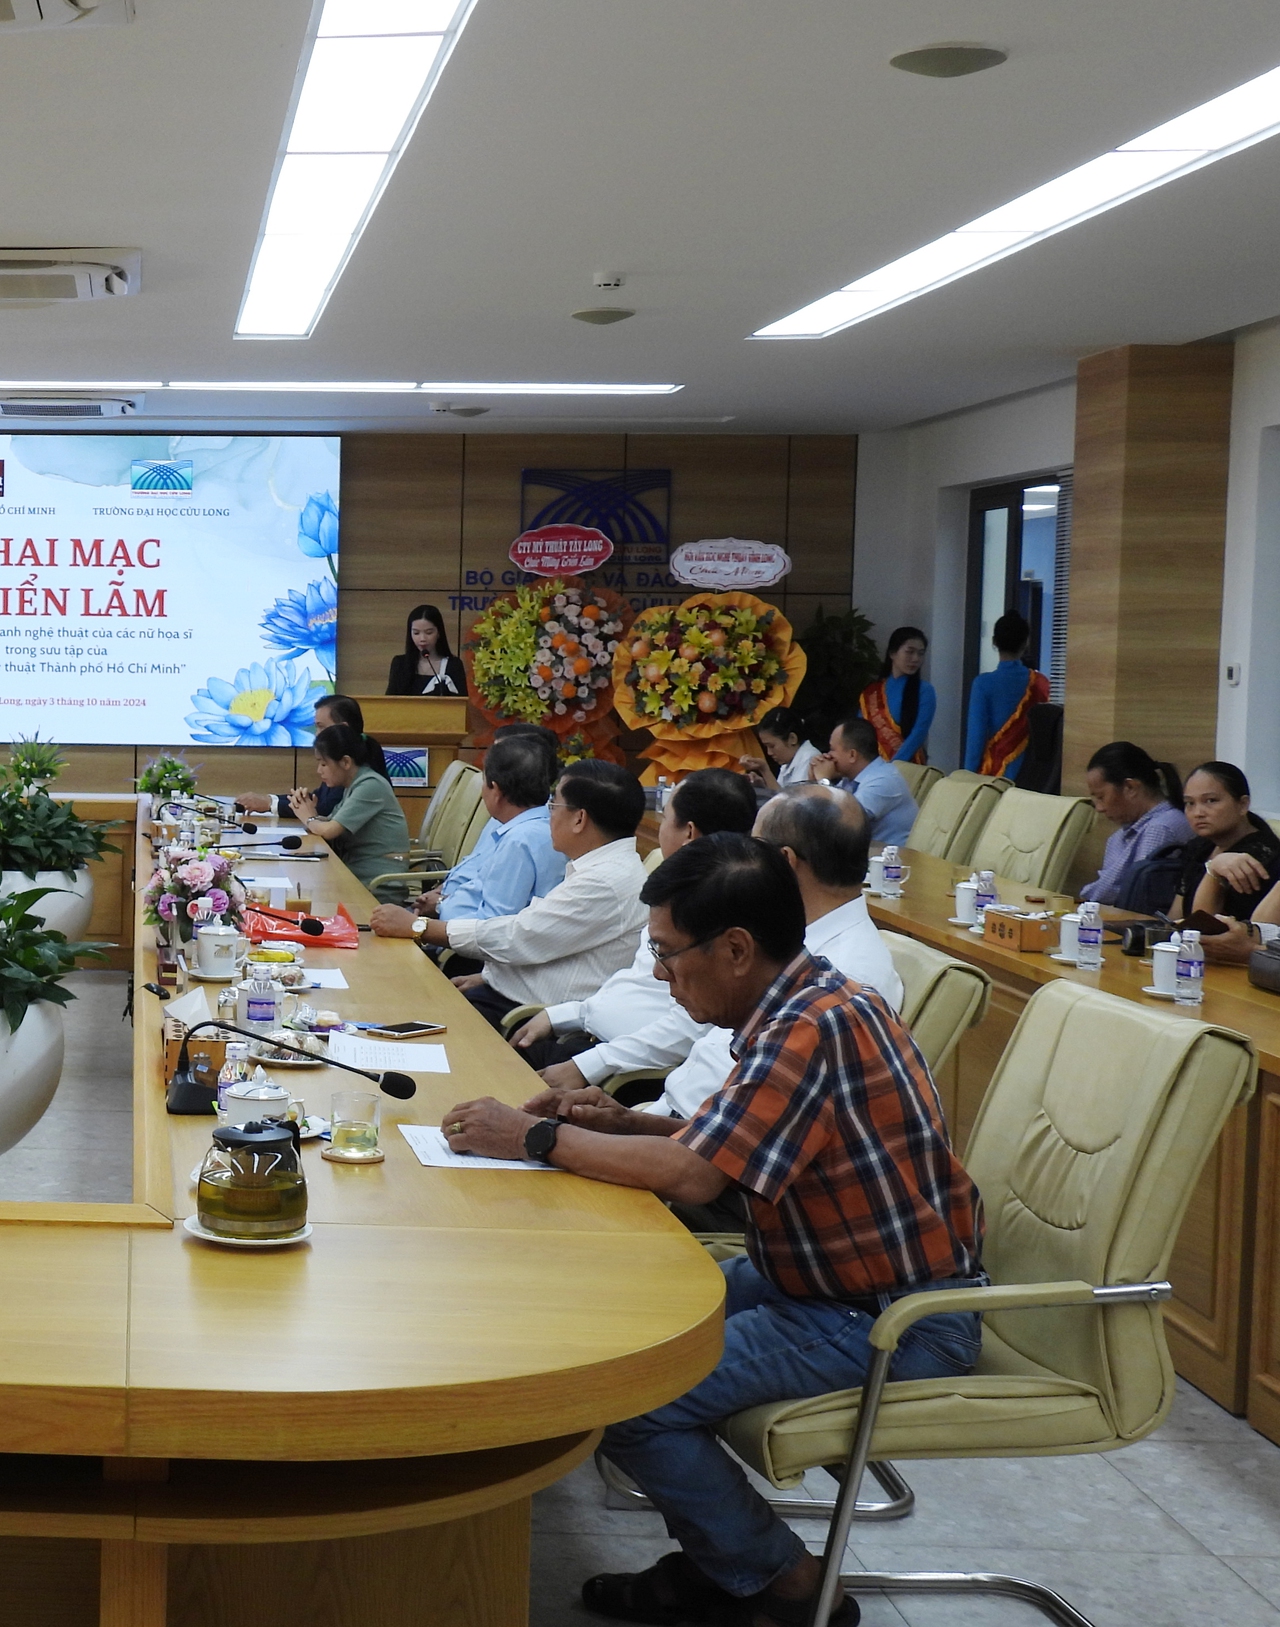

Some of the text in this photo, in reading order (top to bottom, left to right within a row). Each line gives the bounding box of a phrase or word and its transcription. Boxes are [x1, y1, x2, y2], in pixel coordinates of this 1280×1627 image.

[7, 504, 26, 515] CHÍ
[27, 507, 56, 515] MINH
[92, 506, 135, 517] TRƯỜNG
[136, 507, 155, 518] ĐẠI
[156, 507, 179, 518] HỌC
[202, 508, 230, 517] LONG
[583, 539, 604, 552] LONG
[69, 538, 161, 576] MẠC
[466, 568, 494, 590] BỘ
[80, 580, 168, 618] LÃM
[24, 627, 54, 641] nghệ
[57, 627, 89, 640] thuật
[92, 627, 113, 638] của
[116, 627, 136, 639] các
[139, 627, 156, 639] nữ
[157, 628, 180, 641] họa
[183, 629, 194, 640] sĩ
[5, 645, 108, 658] trong sưu tập của
[4, 661, 36, 675] thuật
[39, 661, 77, 673] Thành
[80, 661, 104, 676] phố
[128, 662, 147, 674] Chí
[25, 697, 47, 707] ngày
[49, 697, 55, 706] 3
[57, 697, 85, 708] tháng
[87, 698, 98, 707] 10
[100, 698, 121, 707] năm
[123, 698, 147, 707] 2024
